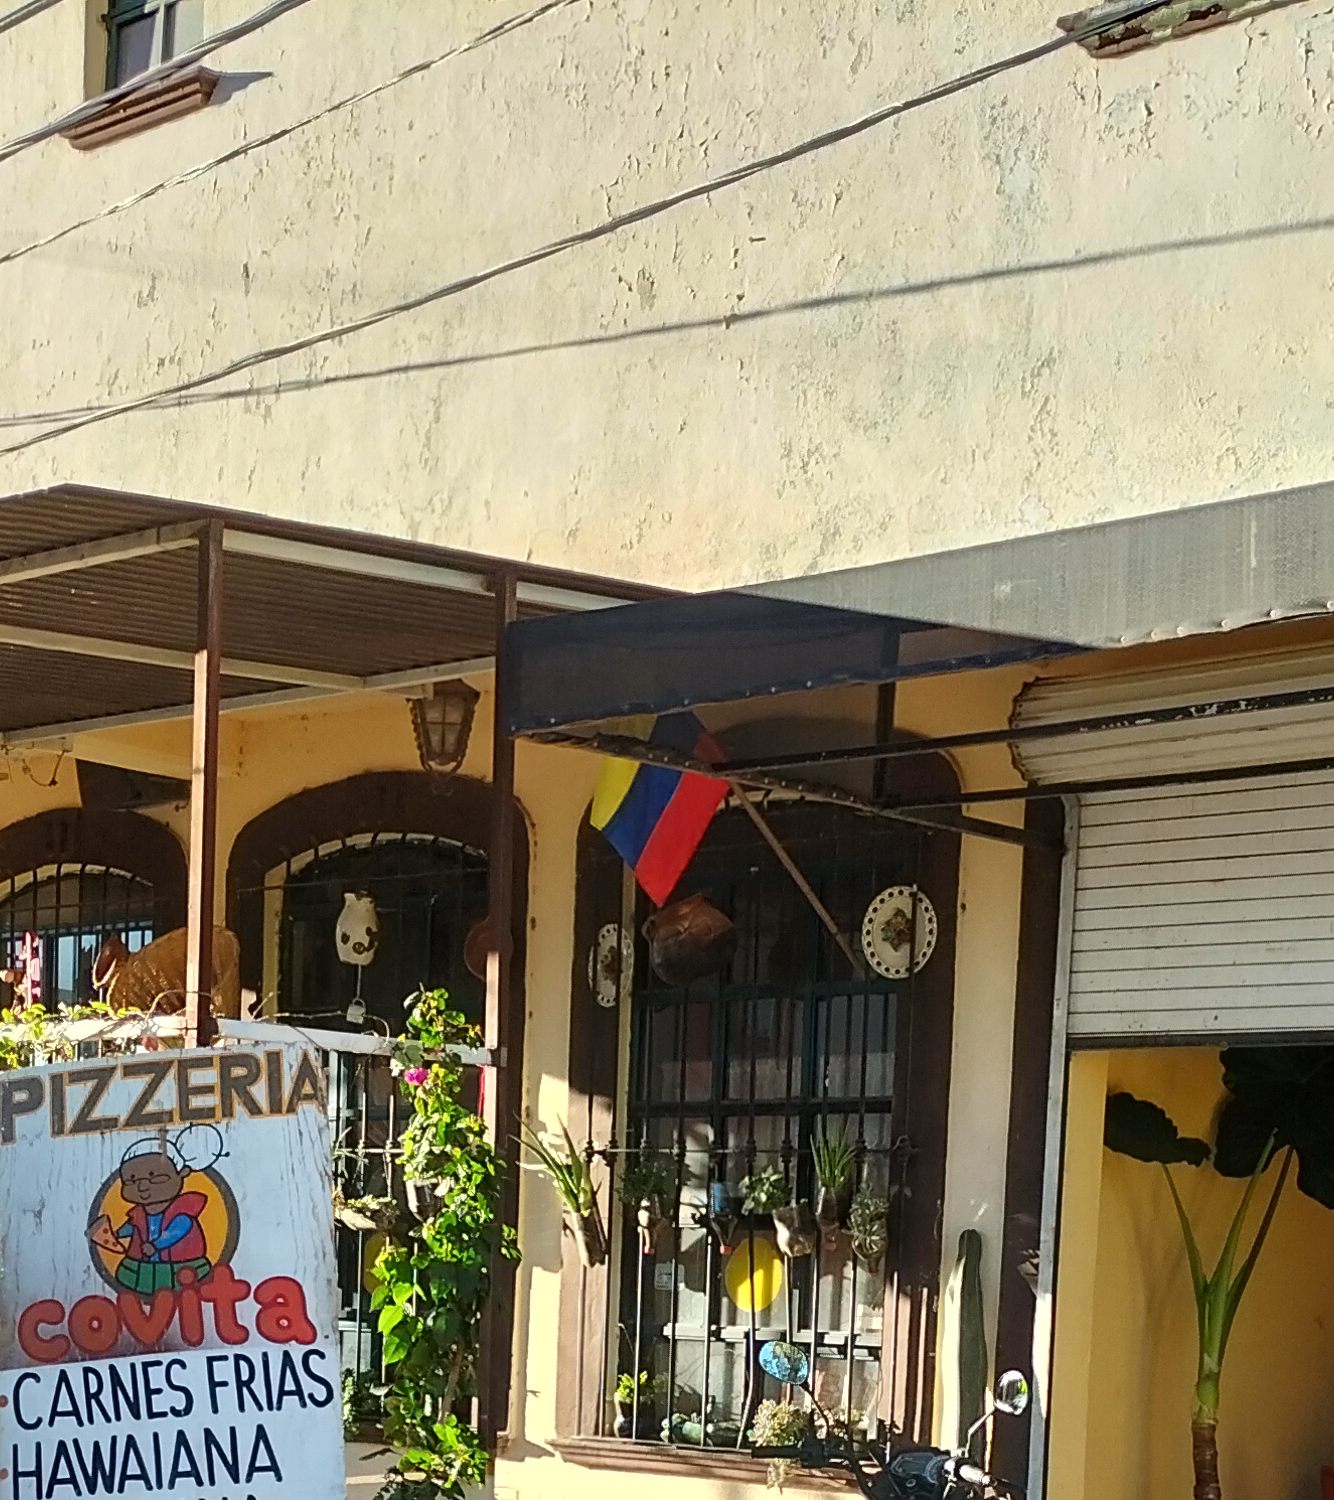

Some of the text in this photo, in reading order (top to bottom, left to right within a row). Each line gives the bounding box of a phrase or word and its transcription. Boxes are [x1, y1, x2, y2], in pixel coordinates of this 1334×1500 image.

[18, 1261, 318, 1363] covita
[12, 1348, 335, 1430] CARNES FRIAS
